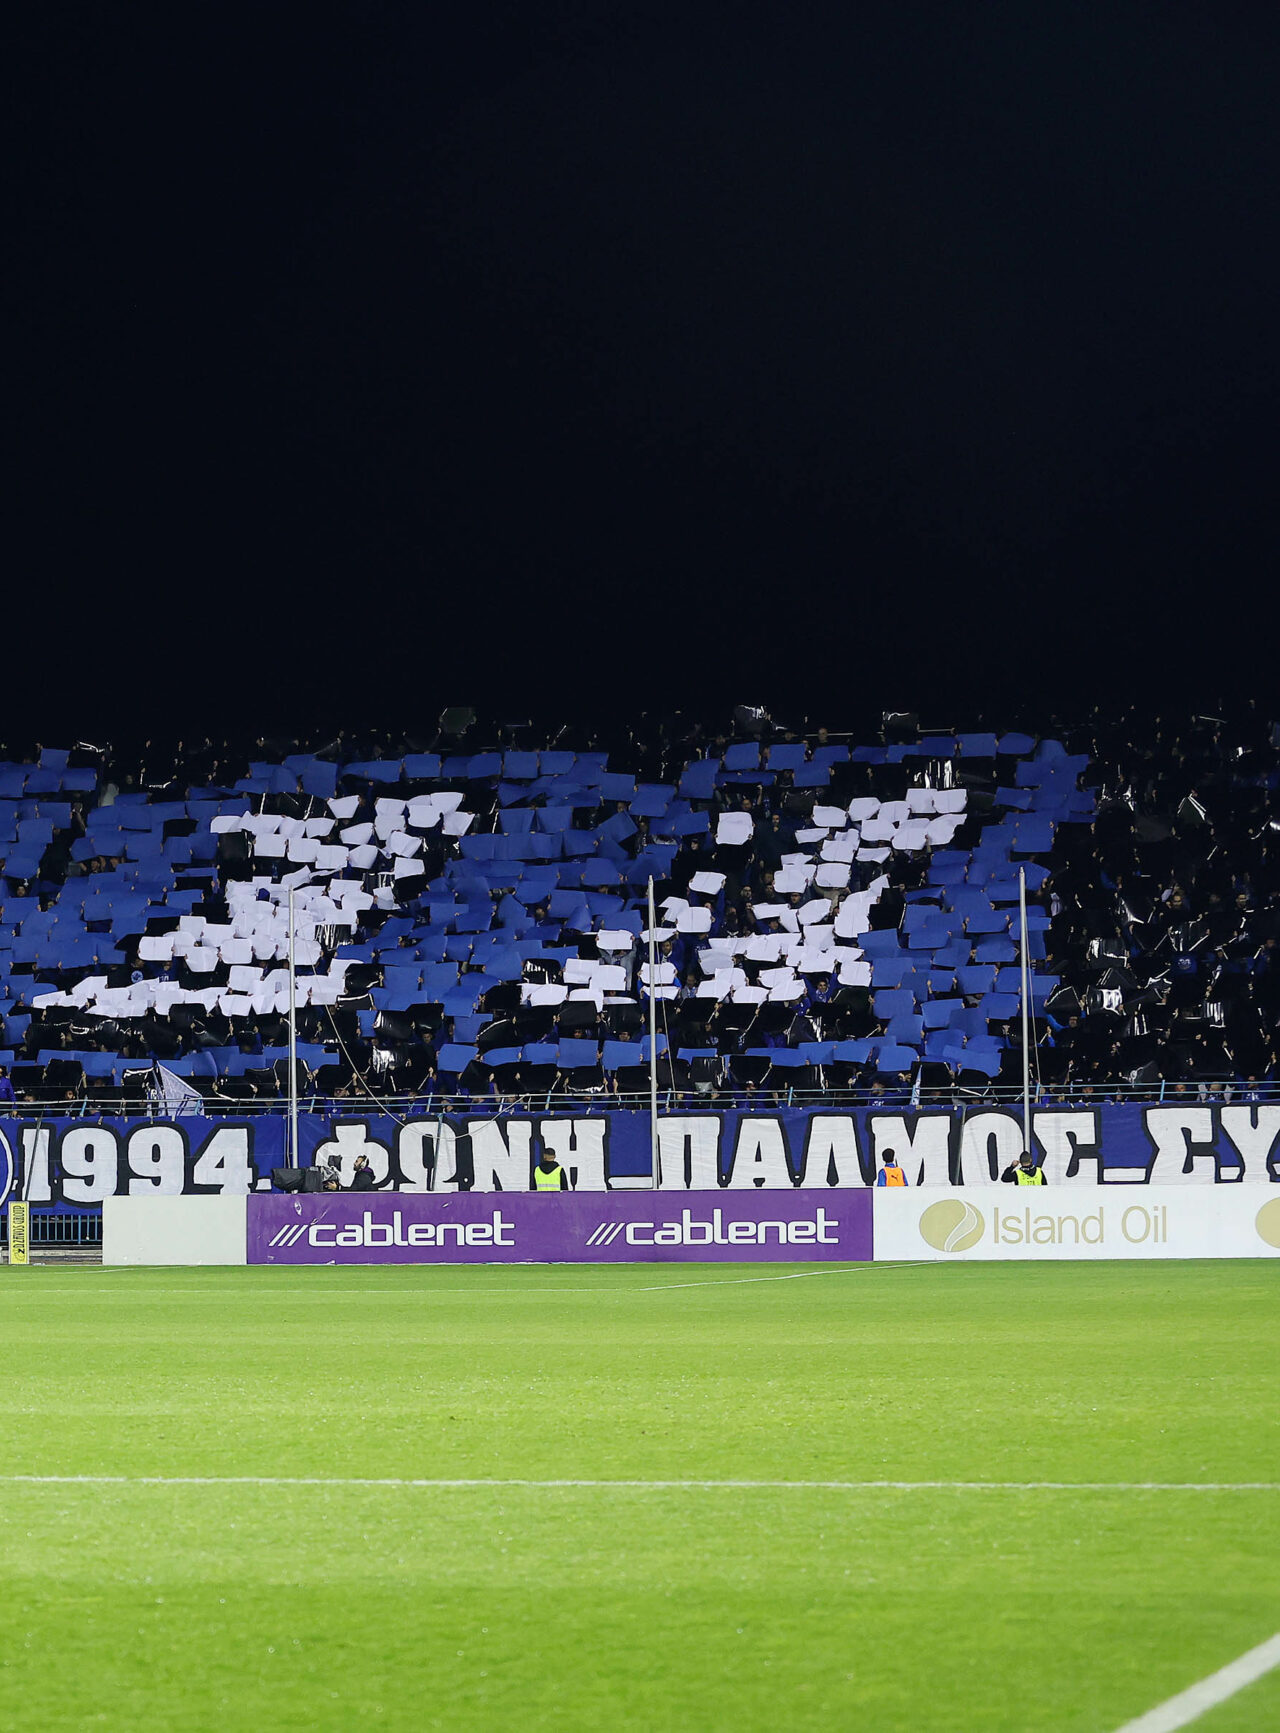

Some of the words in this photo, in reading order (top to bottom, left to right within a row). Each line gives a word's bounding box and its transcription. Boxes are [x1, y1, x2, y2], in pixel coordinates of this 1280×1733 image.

[22, 1126, 253, 1202] 1994
[315, 1119, 608, 1192] ΦΩΝΗ
[657, 1111, 1098, 1188] ΠΑΛΜΟΣ
[308, 1210, 516, 1247] cablenet
[625, 1208, 839, 1244] cablenet
[993, 1206, 1105, 1244] Island
[1121, 1205, 1168, 1244] Oil
